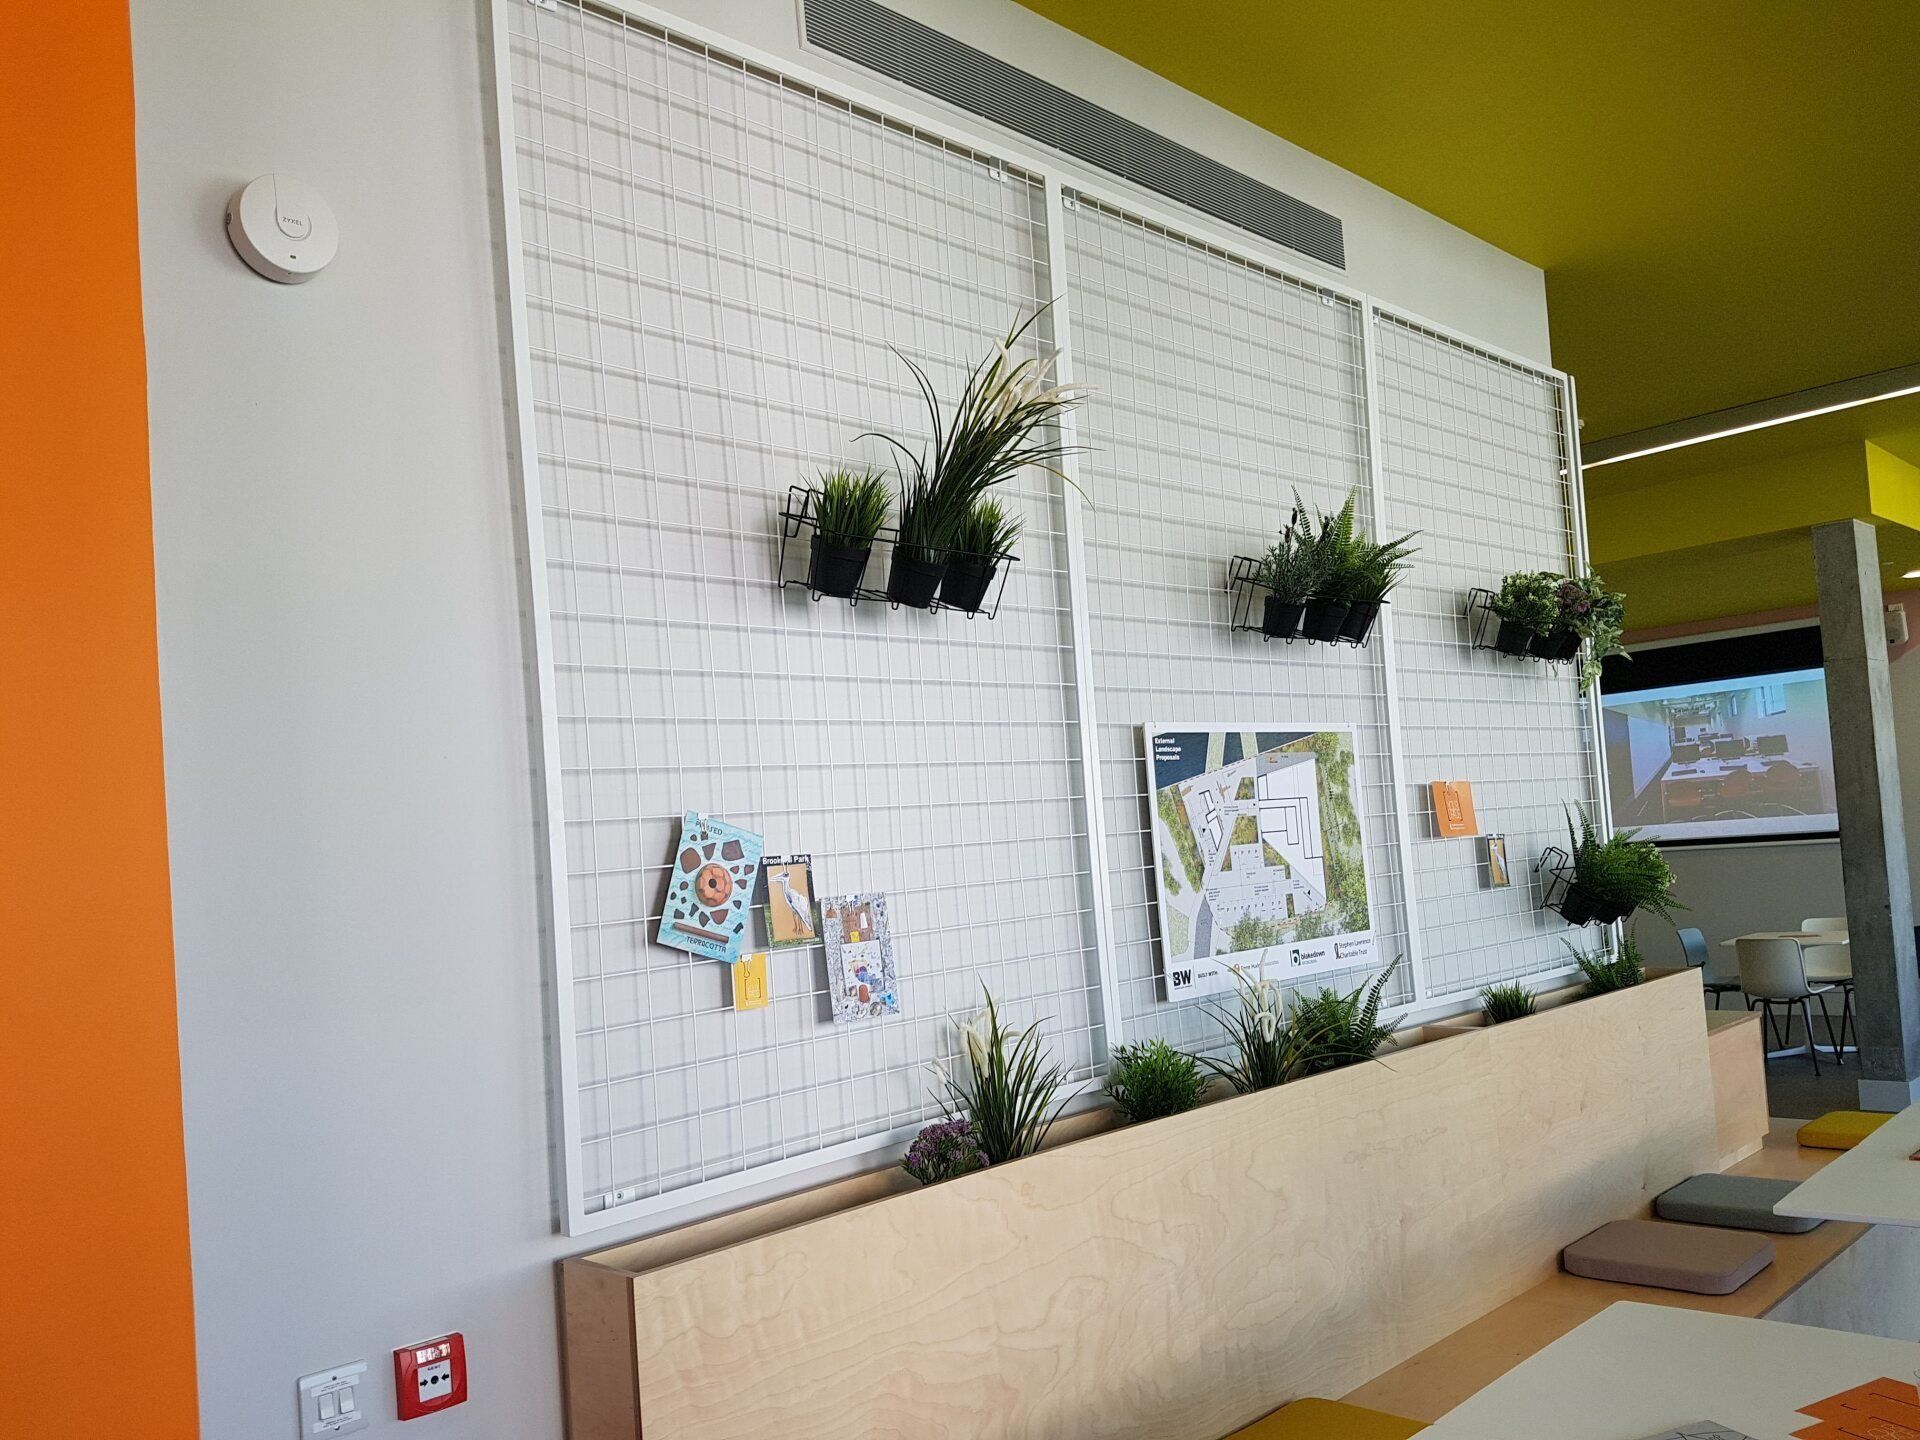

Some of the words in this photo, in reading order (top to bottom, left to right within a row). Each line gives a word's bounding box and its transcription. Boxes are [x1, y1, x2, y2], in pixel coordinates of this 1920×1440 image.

[793, 855, 810, 863] Park
[685, 935, 727, 953] TERRACOTTA
[1338, 941, 1354, 949] Stephen
[1301, 950, 1326, 960] blakedown
[1340, 950, 1359, 959] Charitable
[1172, 969, 1192, 987] BW
